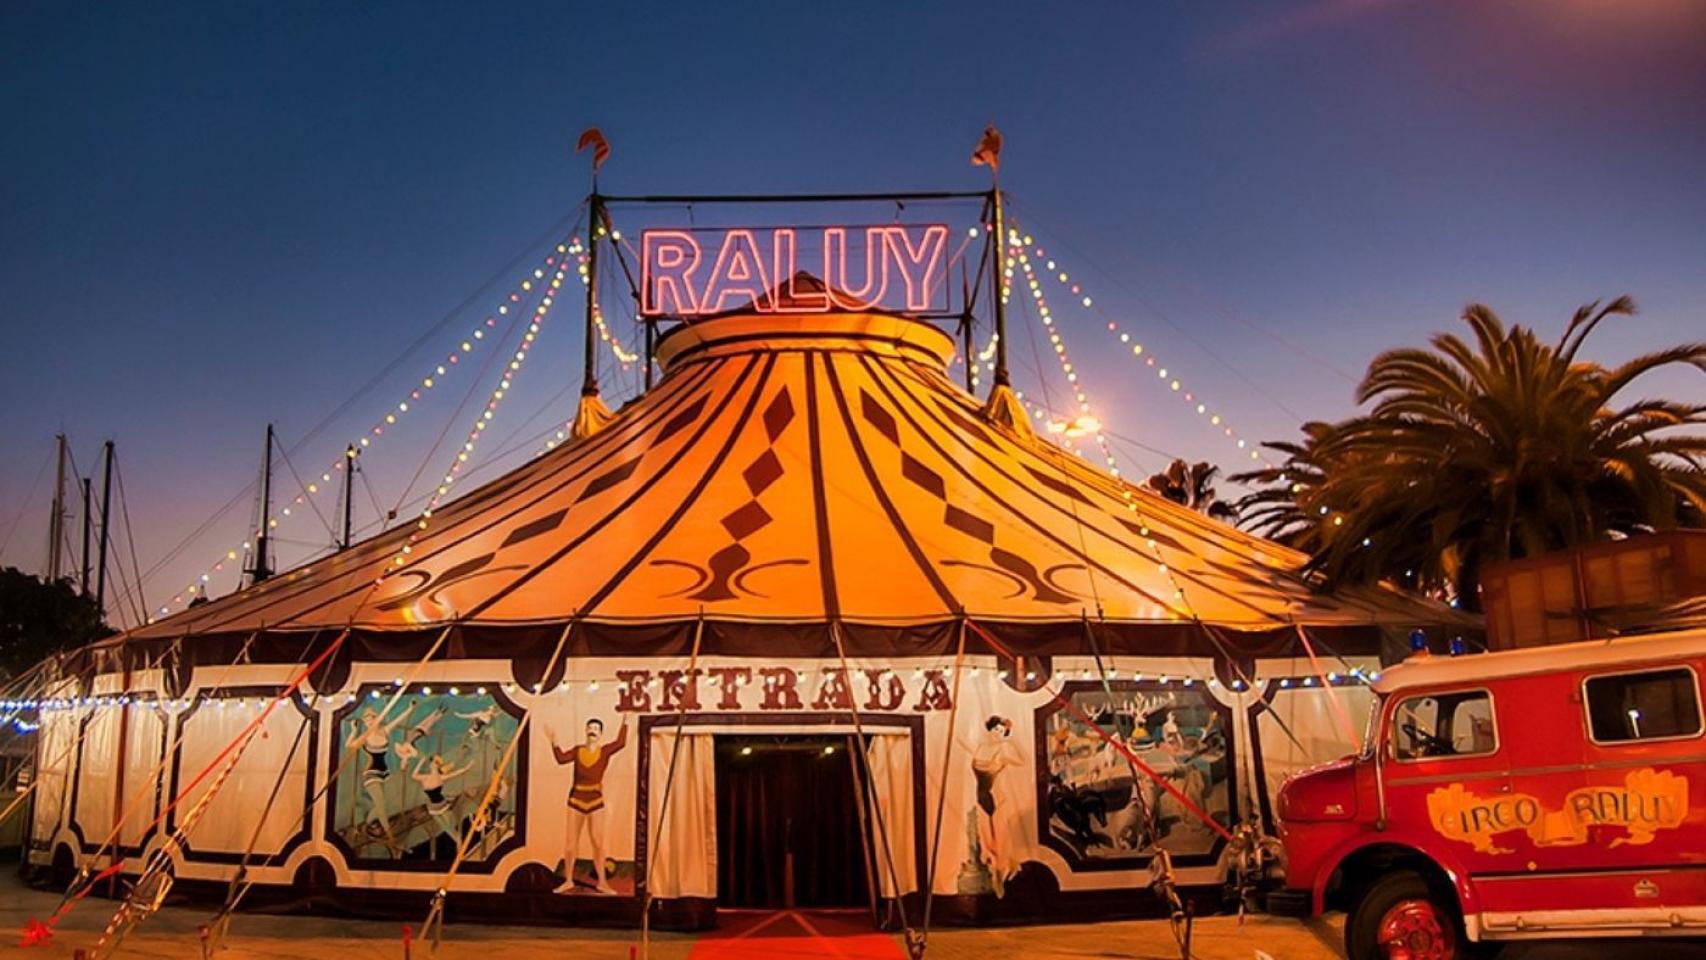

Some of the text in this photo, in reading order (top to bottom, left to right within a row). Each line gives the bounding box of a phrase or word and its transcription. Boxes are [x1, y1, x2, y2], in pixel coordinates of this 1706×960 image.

[641, 227, 948, 314] RALUY
[615, 667, 953, 712] ENTRADA
[1440, 798, 1538, 834] CIRCO
